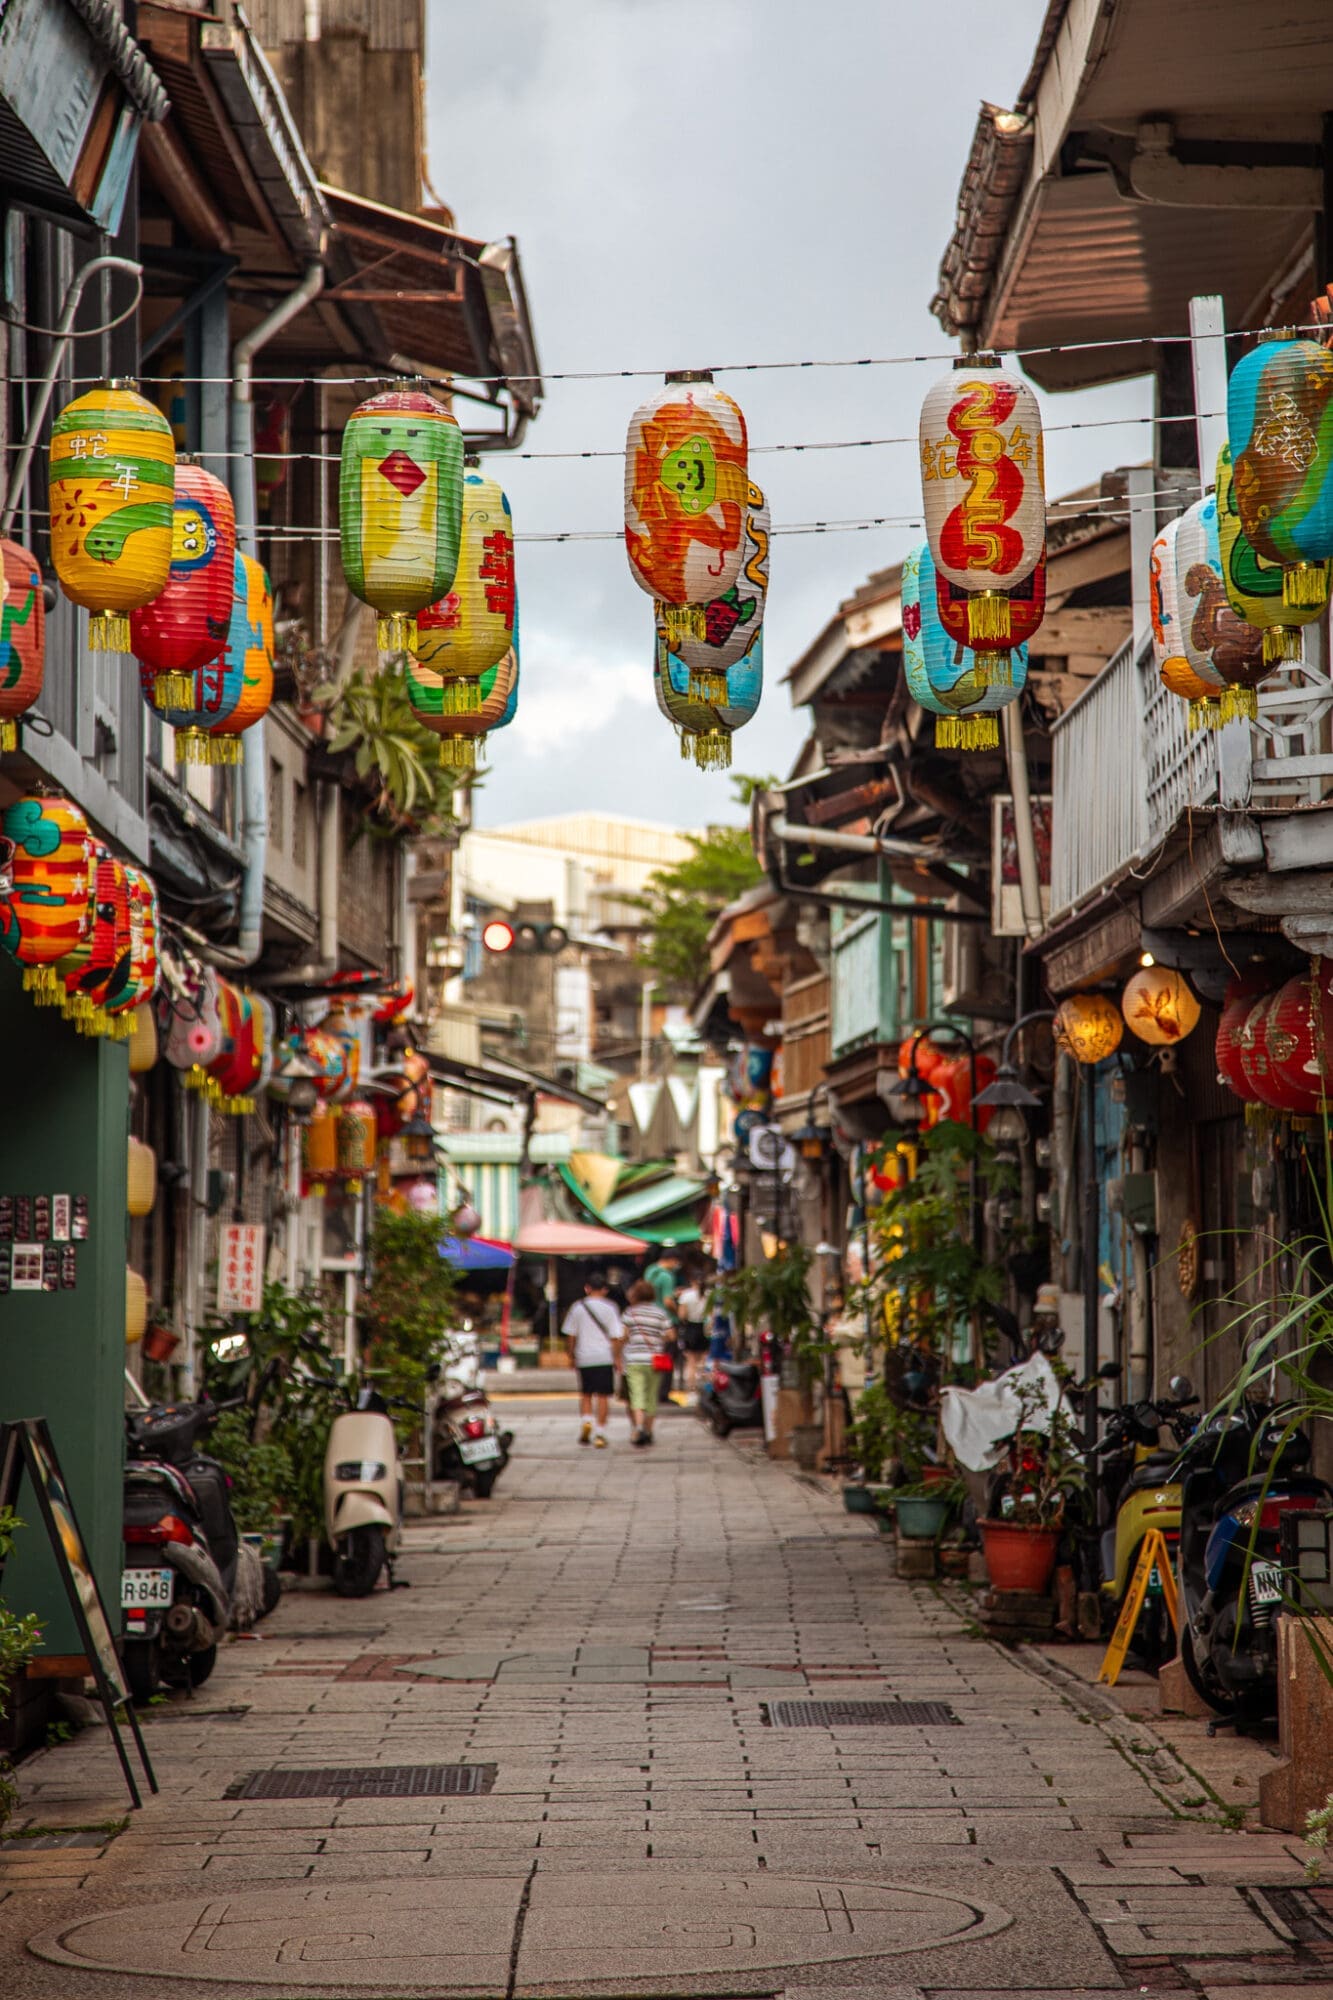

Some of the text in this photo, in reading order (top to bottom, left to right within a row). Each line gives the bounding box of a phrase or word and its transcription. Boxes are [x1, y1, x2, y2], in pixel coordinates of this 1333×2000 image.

[1007, 424, 1033, 468] 年
[956, 380, 1006, 569] 2025
[121, 1582, 169, 1600] R-848
